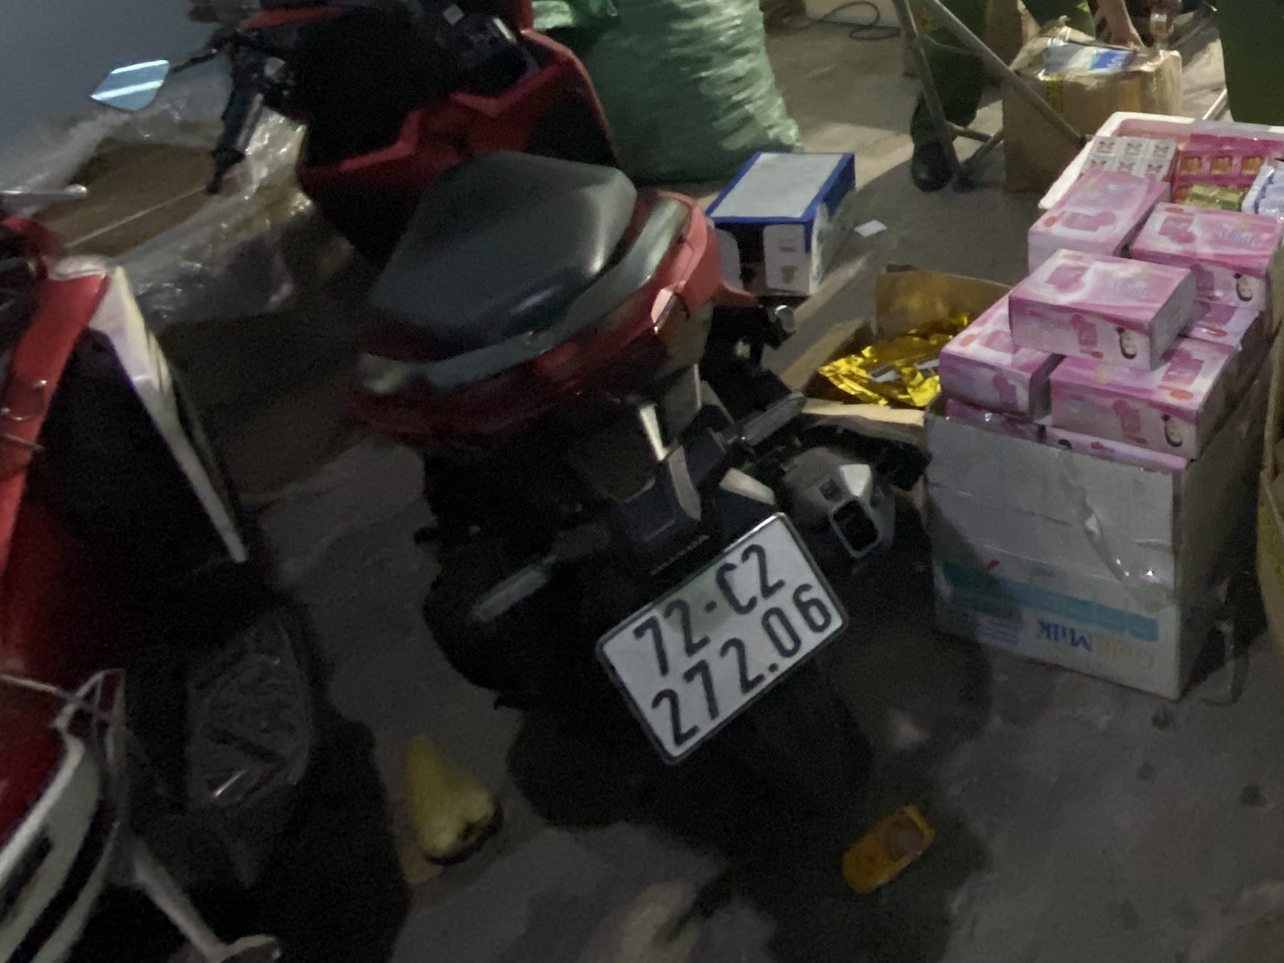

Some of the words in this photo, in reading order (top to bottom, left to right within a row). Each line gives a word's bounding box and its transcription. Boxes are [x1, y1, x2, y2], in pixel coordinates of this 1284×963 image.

[633, 543, 786, 677] 72-C2
[651, 583, 832, 747] 272.06
[1037, 619, 1093, 654] Milk
